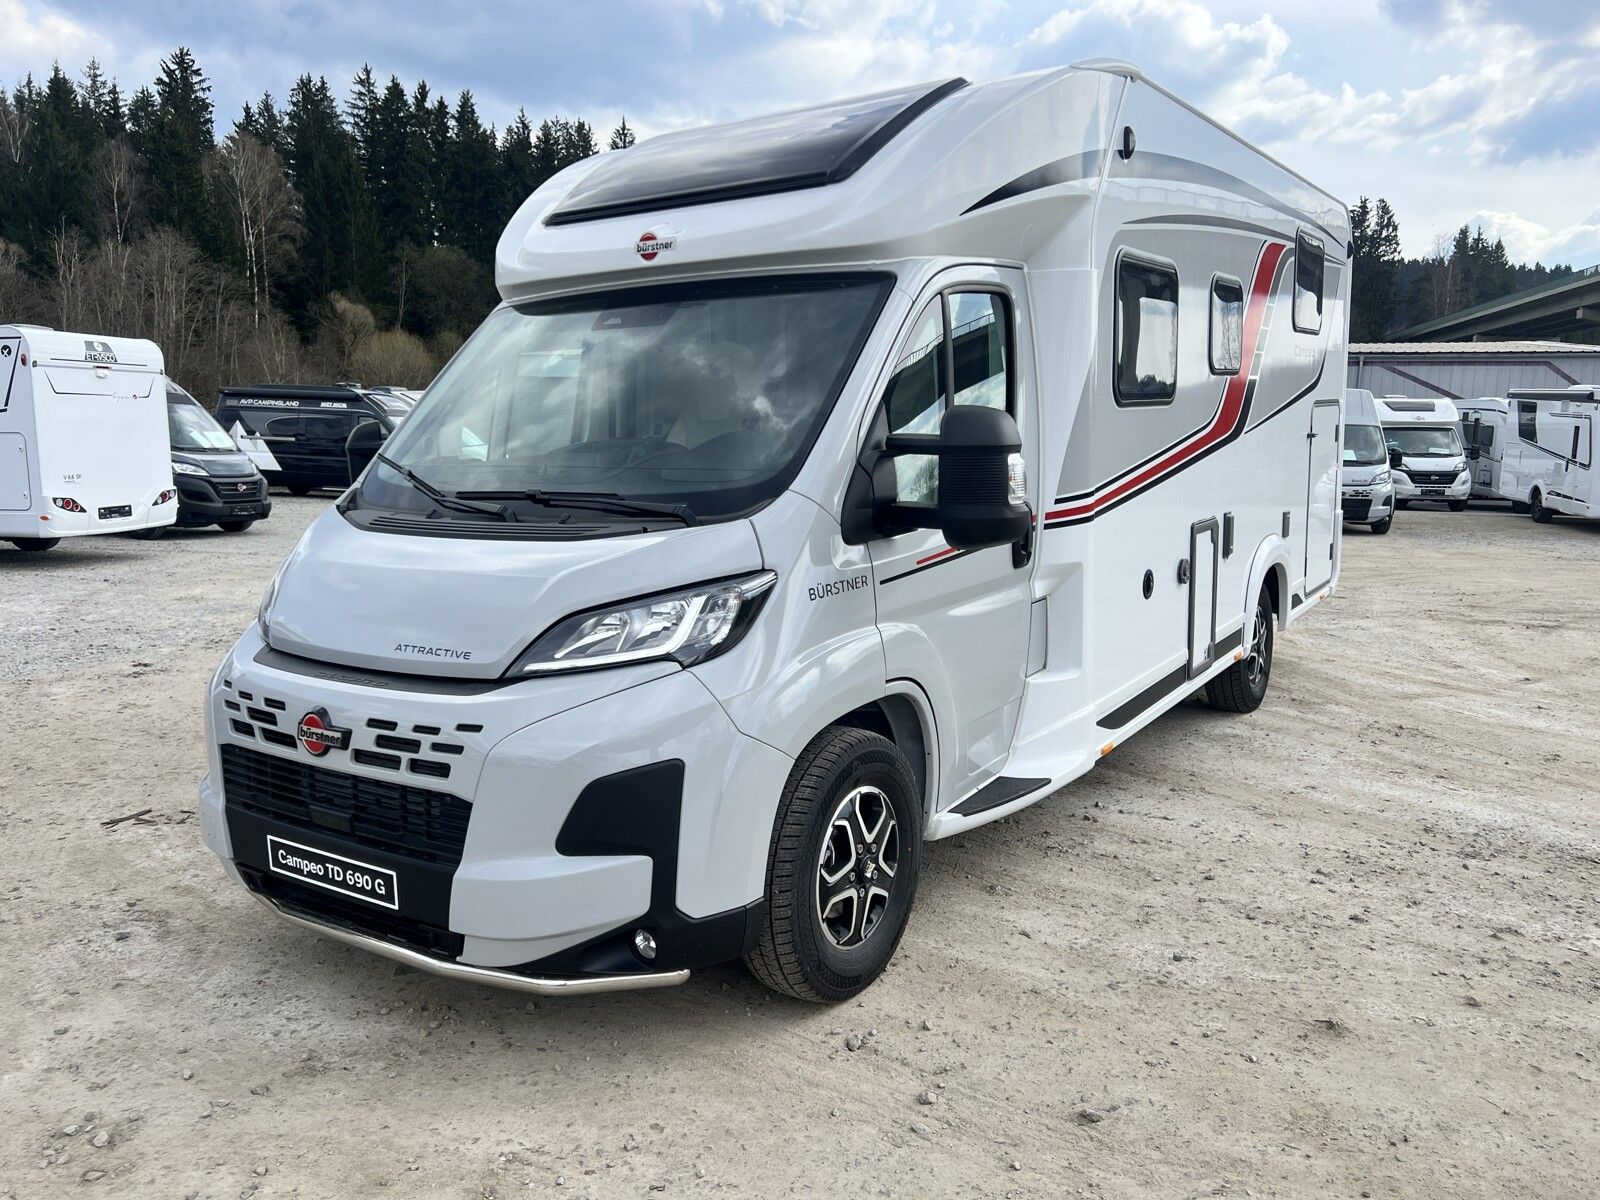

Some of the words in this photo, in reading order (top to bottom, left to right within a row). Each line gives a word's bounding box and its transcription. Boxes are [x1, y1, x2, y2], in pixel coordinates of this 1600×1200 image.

[636, 241, 674, 253] bürstner
[253, 399, 300, 407] CAMPINGLAND
[808, 575, 869, 601] BÜRSTNER
[394, 643, 472, 660] ATTRACTIVE
[300, 725, 341, 746] bürstner
[278, 849, 325, 875] Campeo
[325, 863, 344, 882] TD
[346, 870, 372, 891] 690
[374, 878, 386, 895] G
